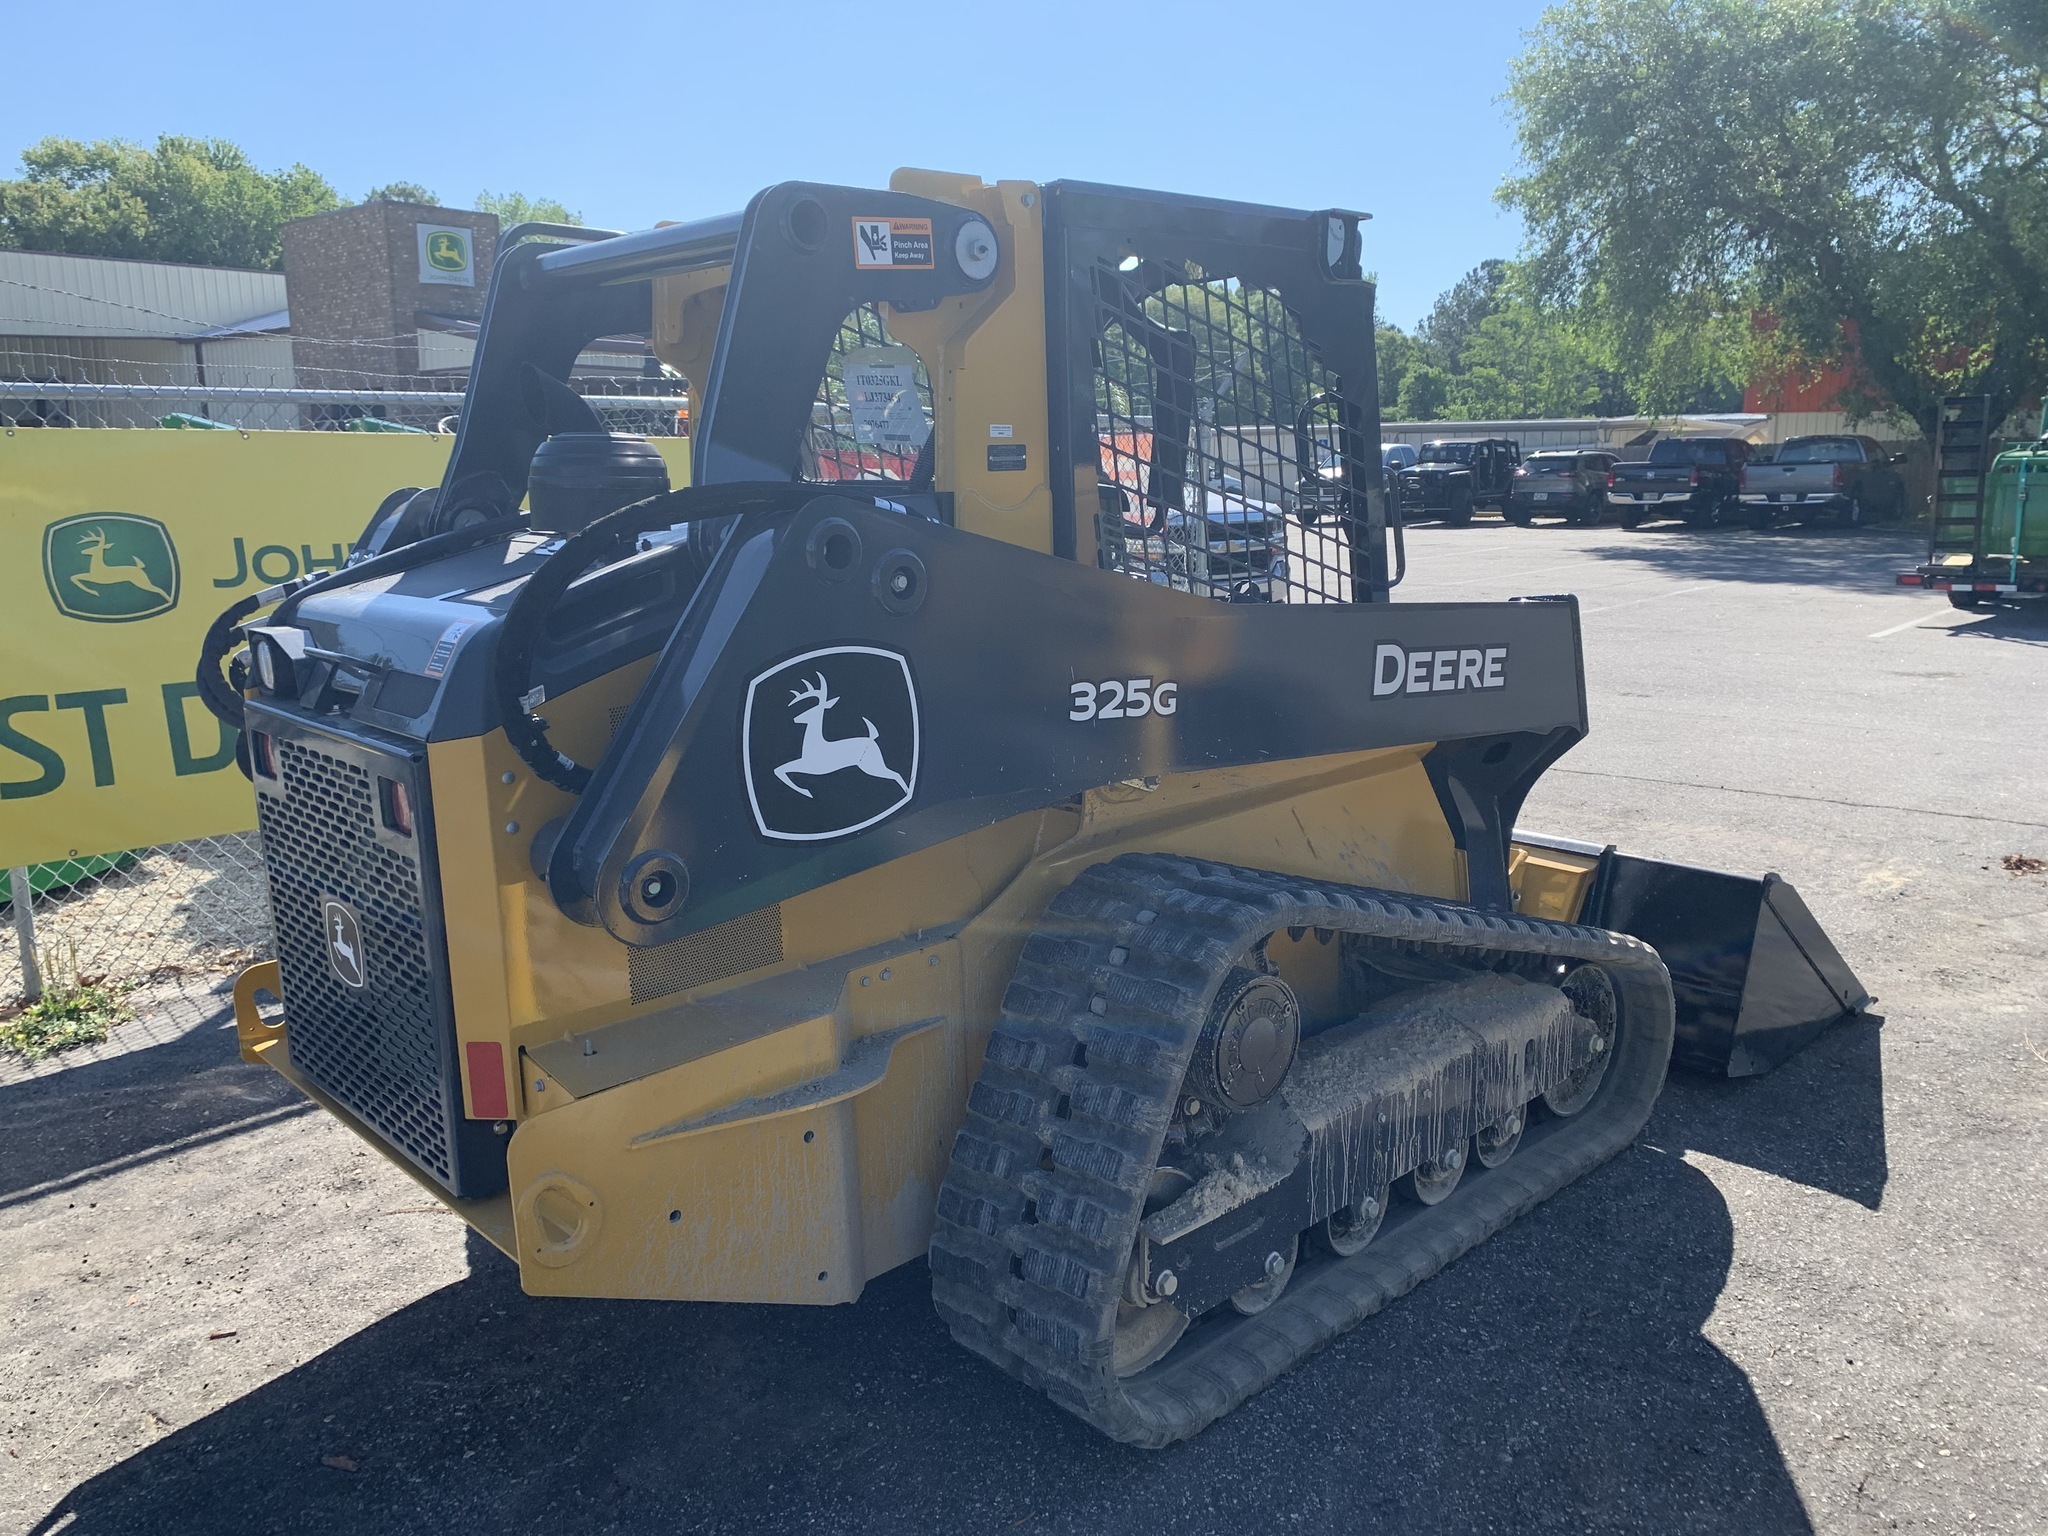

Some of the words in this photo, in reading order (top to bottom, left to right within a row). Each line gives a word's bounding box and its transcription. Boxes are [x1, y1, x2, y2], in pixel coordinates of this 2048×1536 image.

[898, 222, 929, 231] WARNING
[893, 240, 913, 249] Pinch
[913, 241, 929, 249] Area
[894, 252, 908, 260] Keep
[909, 252, 925, 260] Away
[212, 536, 358, 589] JOH
[1372, 643, 1507, 696] DEERE
[1069, 678, 1178, 722] 325G
